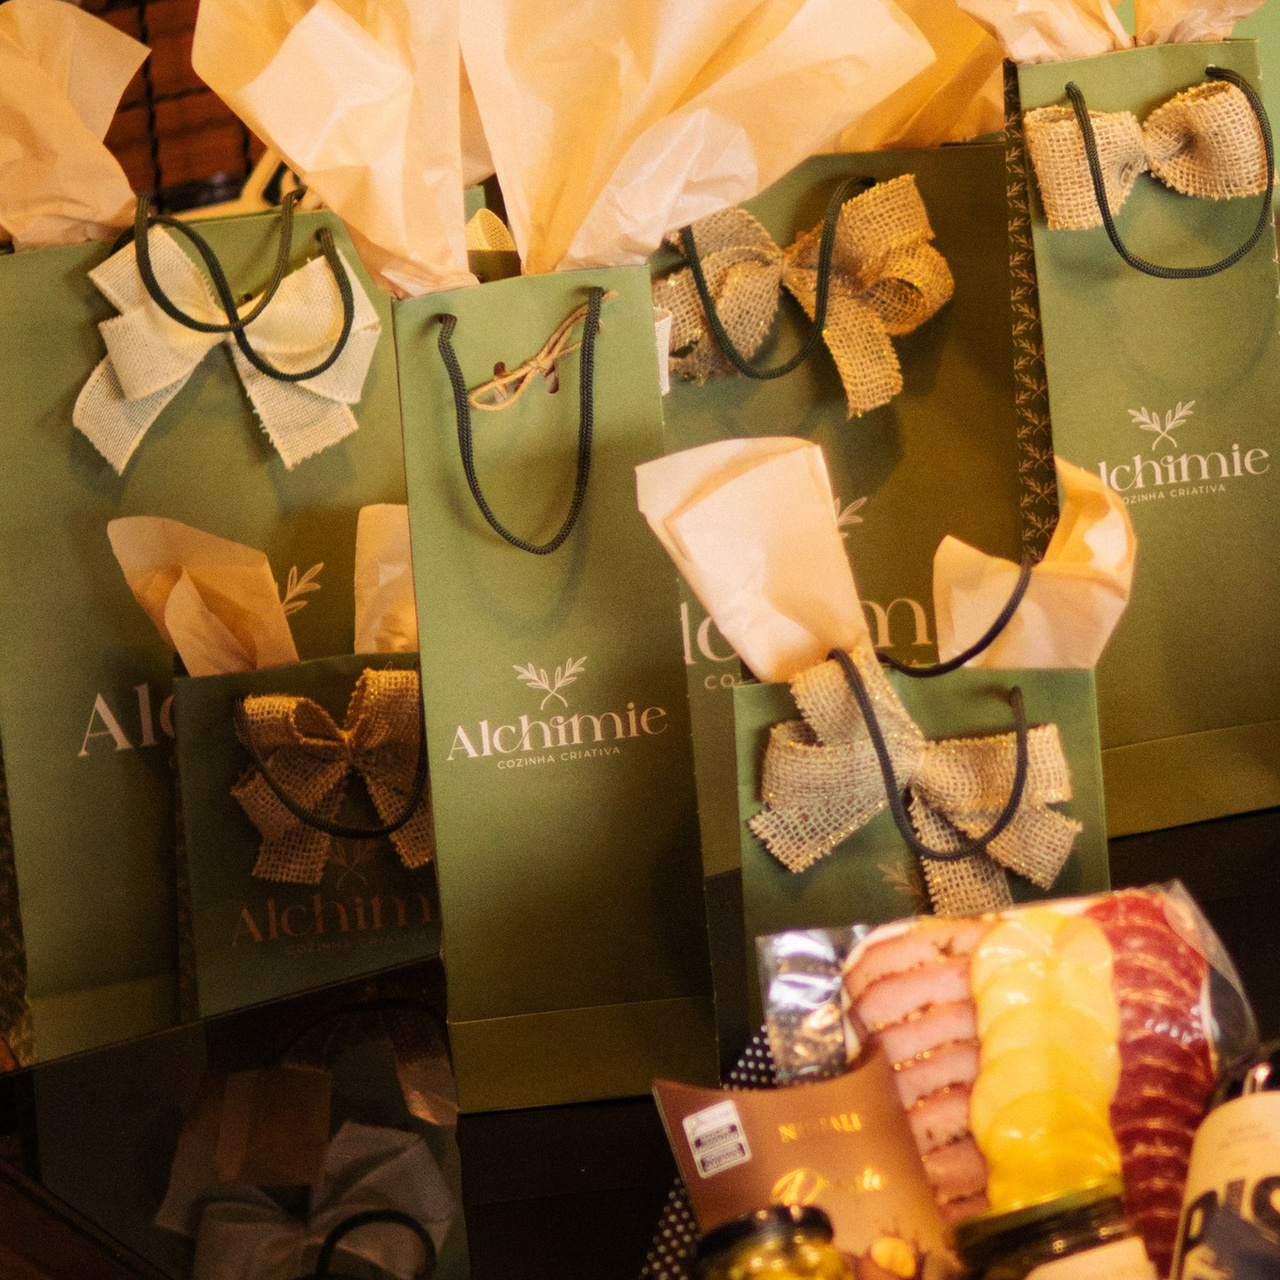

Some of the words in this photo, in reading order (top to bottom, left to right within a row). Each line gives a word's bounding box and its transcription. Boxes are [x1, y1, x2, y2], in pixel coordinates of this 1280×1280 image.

[1098, 443, 1270, 492] lchimie
[1121, 492, 1165, 505] OZINHA
[1170, 484, 1226, 498] CRIATIVA
[446, 701, 668, 761] Alchimie
[497, 754, 556, 770] COZINHA
[560, 746, 621, 762] CRIATIVA
[231, 893, 433, 947] Alchim
